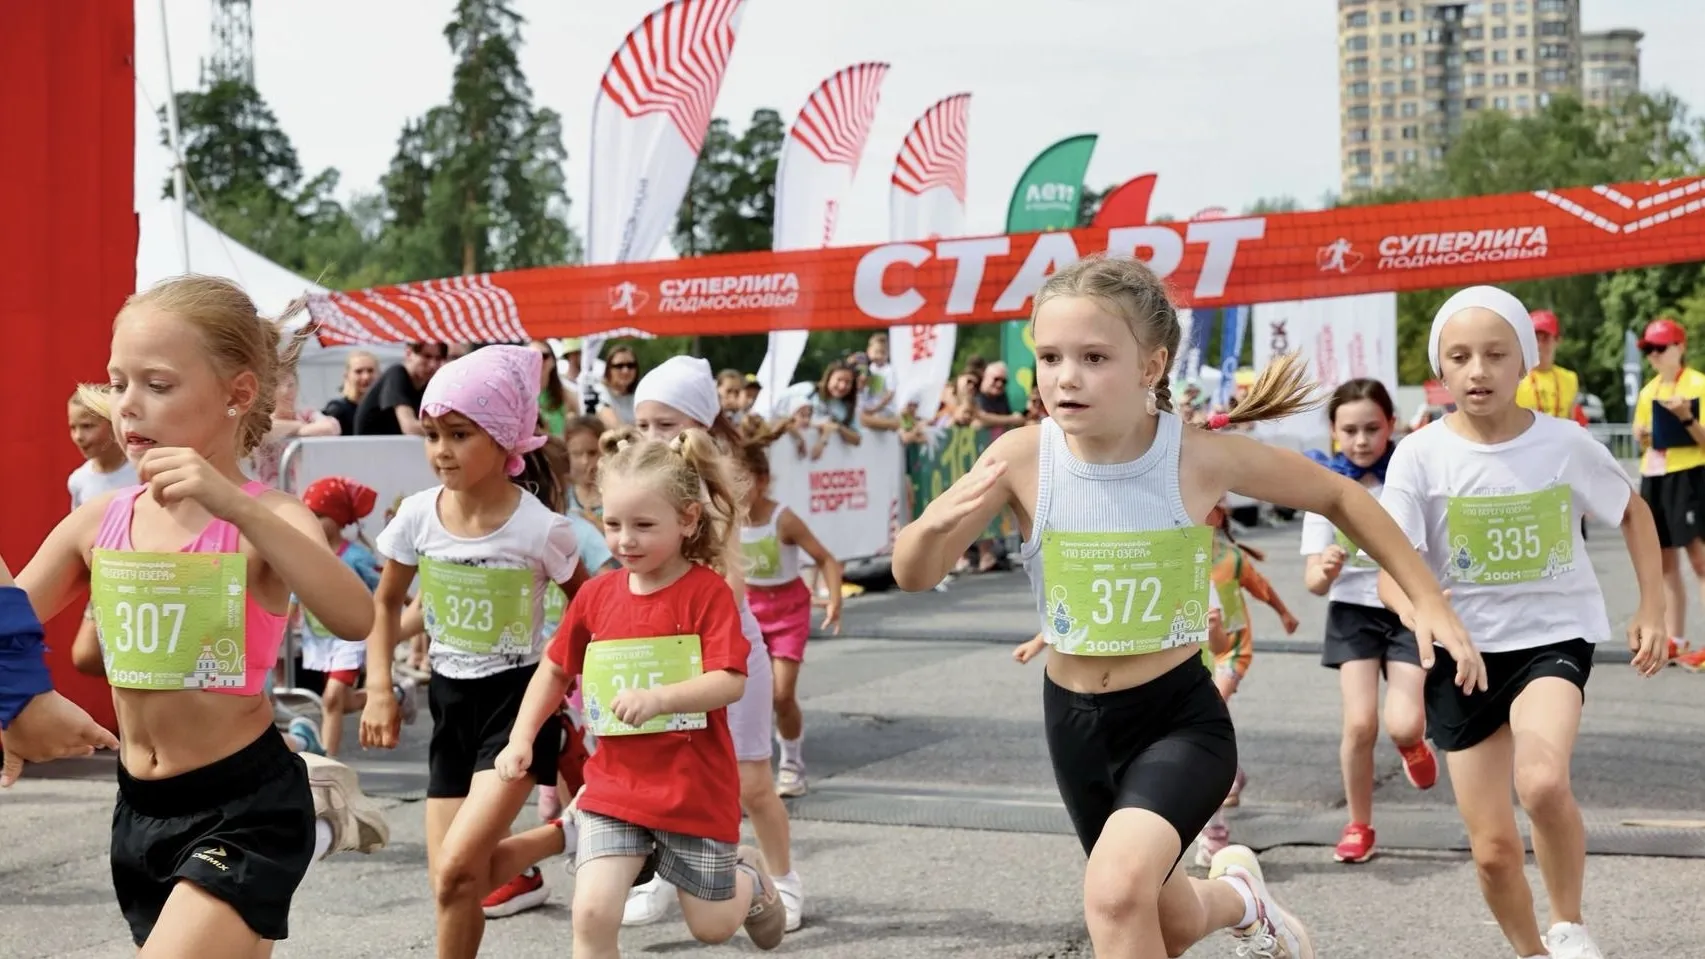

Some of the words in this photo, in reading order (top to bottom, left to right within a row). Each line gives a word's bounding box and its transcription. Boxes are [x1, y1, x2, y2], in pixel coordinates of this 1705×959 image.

[1377, 245, 1548, 270] ПОДМОСКОВЬЯ
[1378, 225, 1548, 257] СУПЕРЛИГА
[659, 272, 800, 296] СУПЕРЛИГА
[852, 217, 1266, 320] СТАРТ
[658, 292, 799, 313] ПОДМОСКОВЬЯ
[1487, 525, 1541, 561] 335
[445, 595, 493, 632] 323
[1092, 577, 1162, 625] 372
[115, 601, 186, 653] 307
